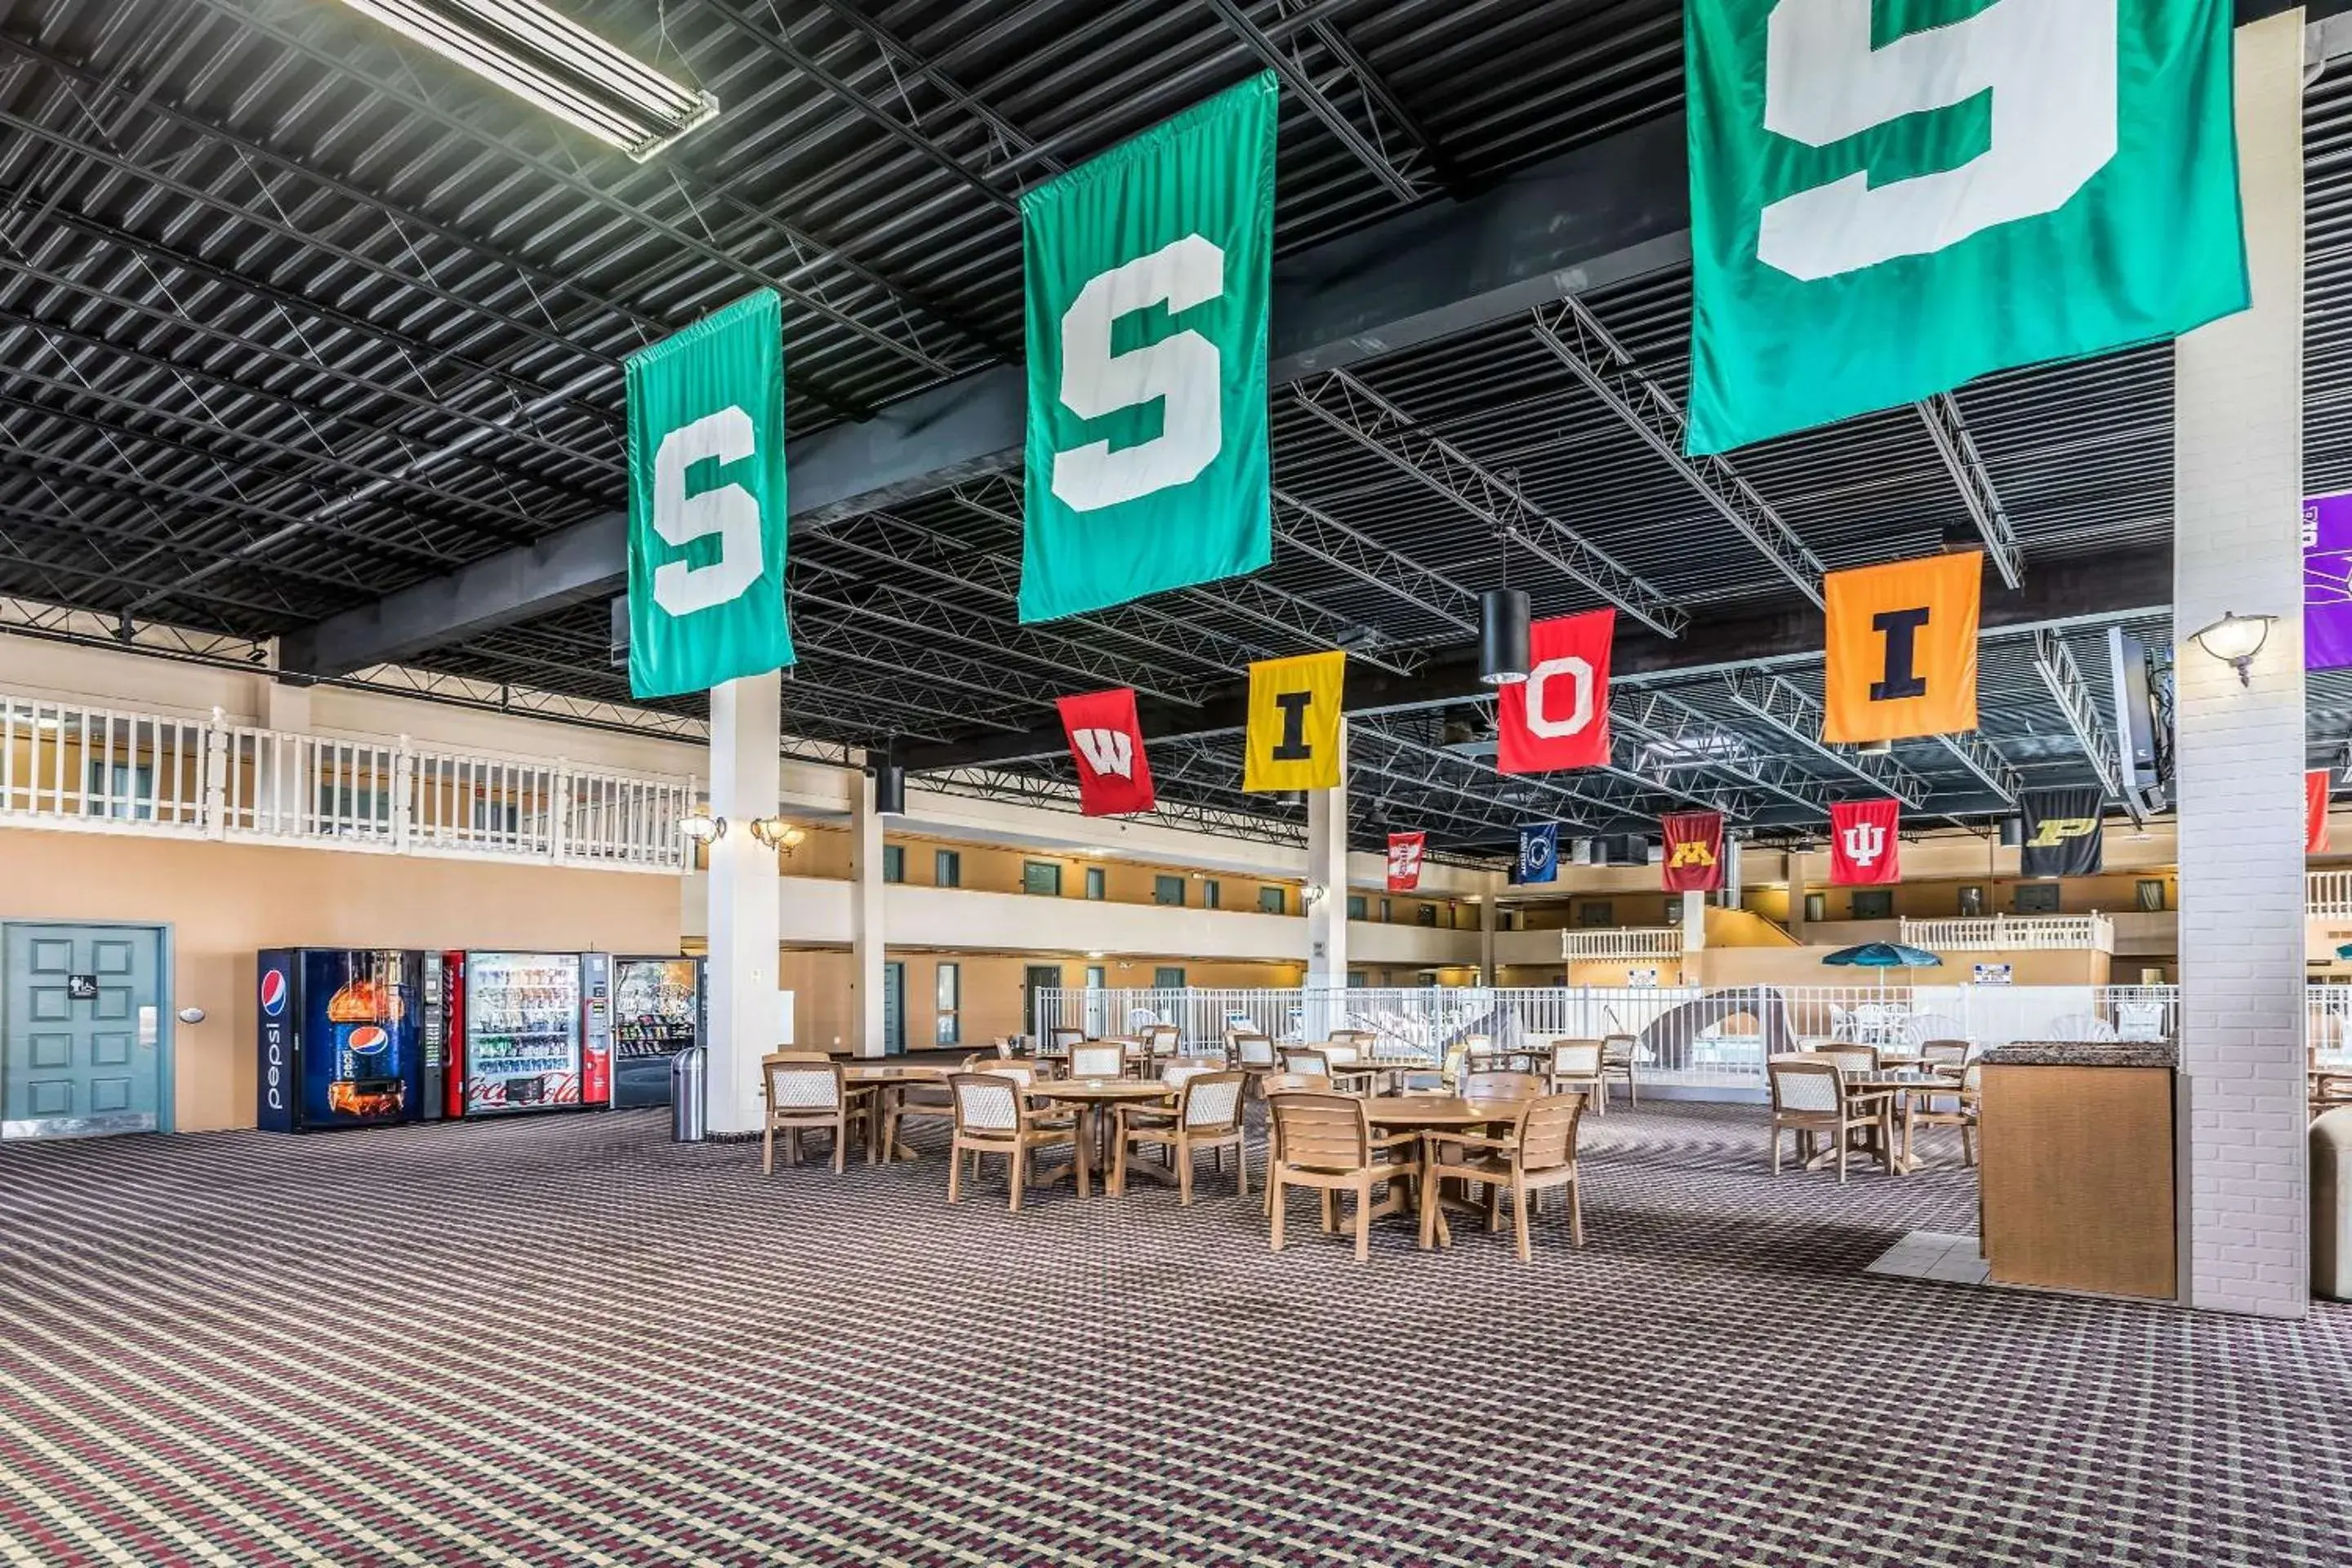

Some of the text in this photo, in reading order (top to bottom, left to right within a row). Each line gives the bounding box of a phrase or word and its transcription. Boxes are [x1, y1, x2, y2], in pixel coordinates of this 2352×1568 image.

[1757, 0, 2117, 281] S
[1052, 233, 1225, 512] S
[653, 404, 764, 617] S
[1869, 607, 1930, 702] I
[1272, 691, 1312, 760] I
[1526, 657, 1592, 739] O
[1072, 728, 1133, 780] W
[1669, 841, 1716, 867] M
[2026, 818, 2096, 847] P
[266, 1022, 283, 1110] pepsi
[342, 1049, 354, 1078] pepsi
[468, 1071, 580, 1106] CocaCola
